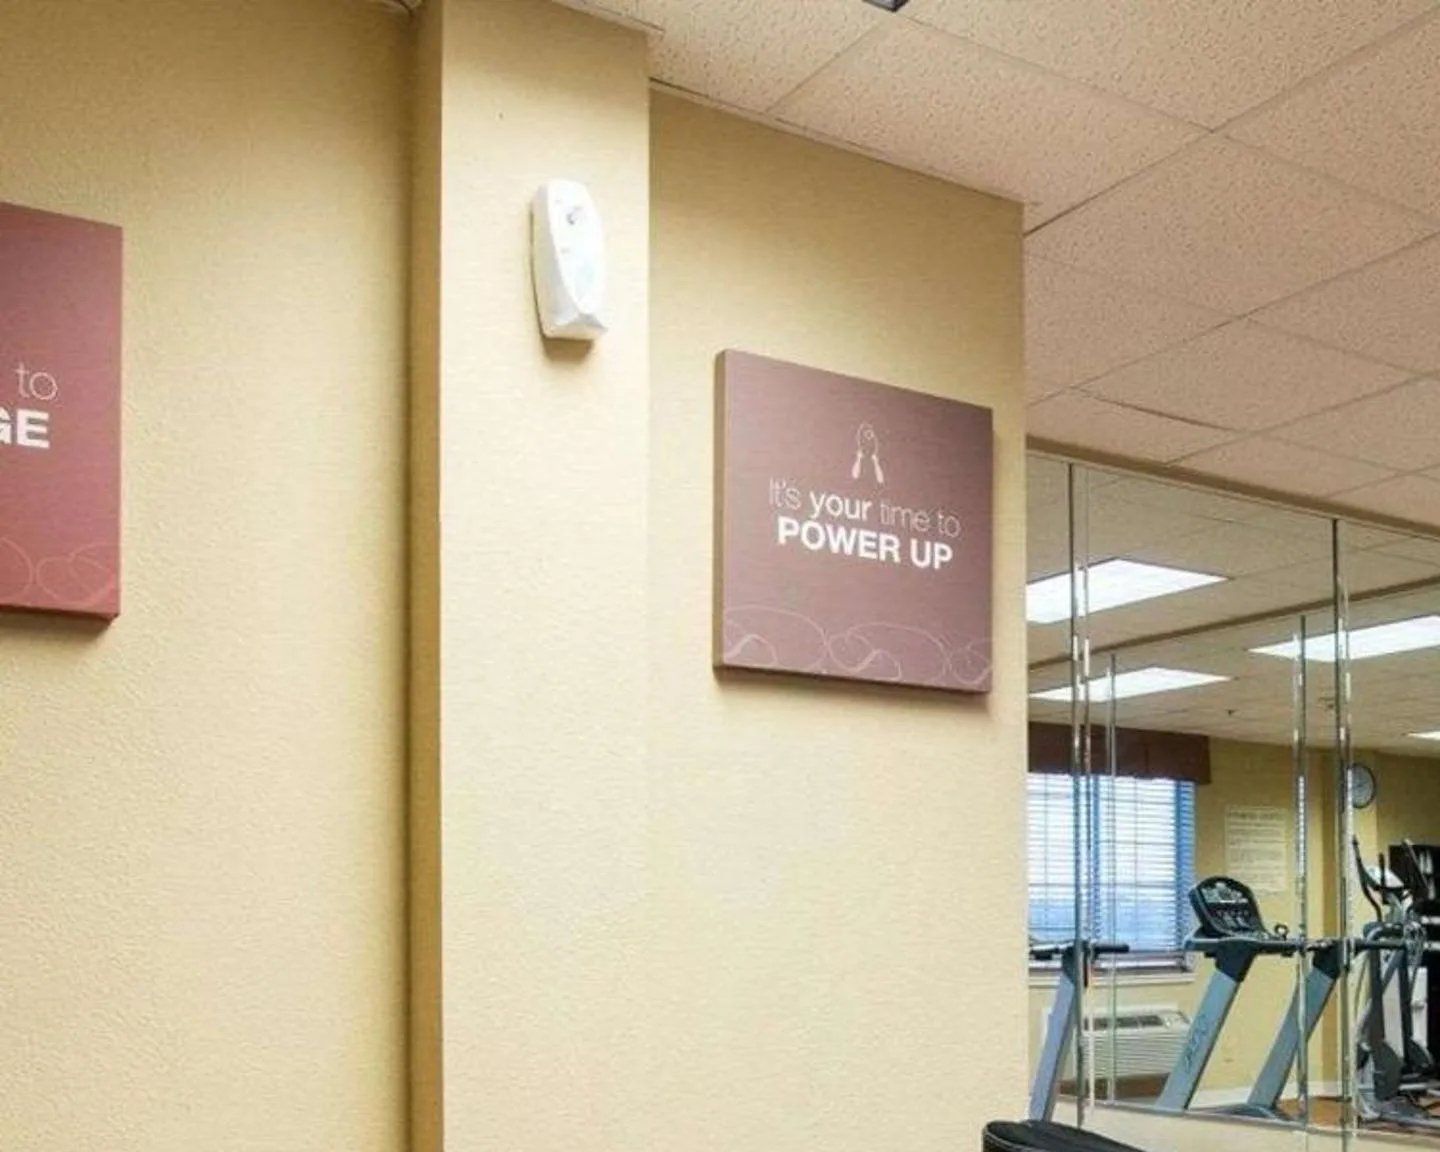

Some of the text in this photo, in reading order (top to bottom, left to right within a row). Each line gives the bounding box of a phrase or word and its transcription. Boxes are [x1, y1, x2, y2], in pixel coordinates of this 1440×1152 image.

[14, 361, 58, 400] to
[768, 477, 961, 538] It's your time to
[777, 516, 954, 570] POWER UP
